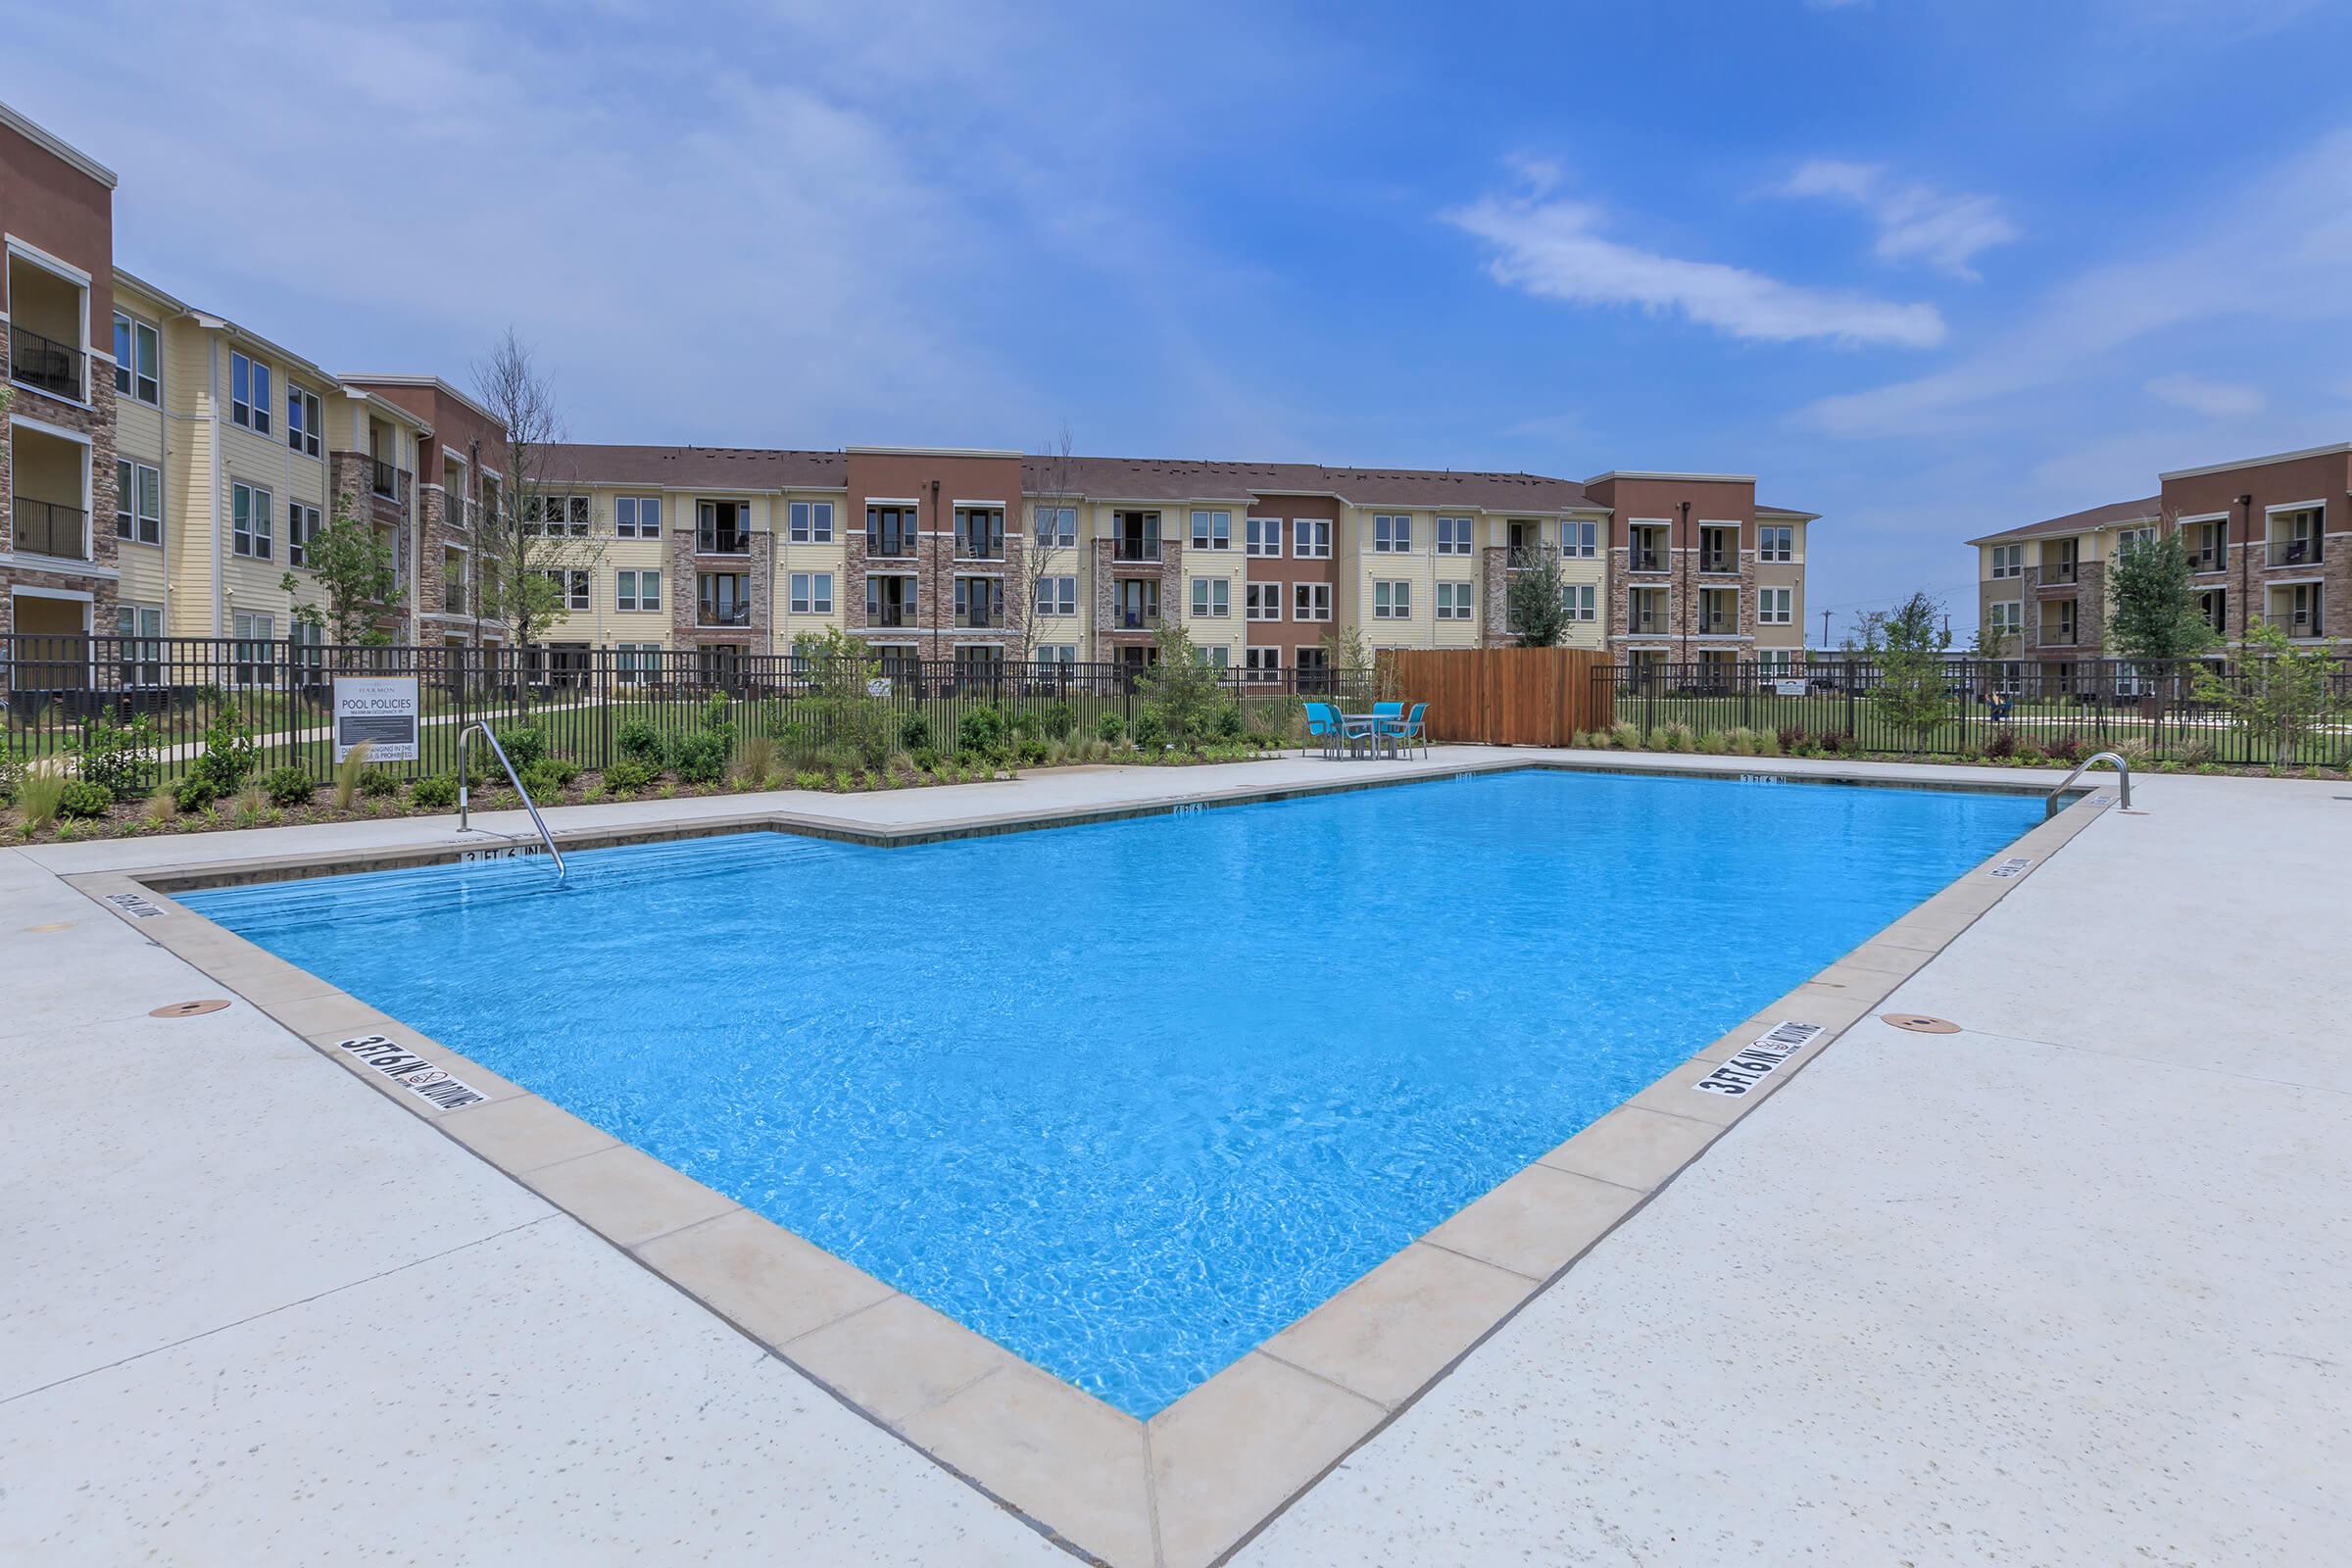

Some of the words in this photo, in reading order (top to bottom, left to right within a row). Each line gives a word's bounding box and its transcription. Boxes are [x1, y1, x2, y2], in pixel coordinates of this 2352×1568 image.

[342, 699, 368, 709] POOL
[371, 699, 412, 709] POLICIES
[341, 1036, 385, 1049] 3
[369, 1054, 416, 1066] 6
[1699, 1081, 1746, 1095] 3
[1730, 1059, 1773, 1072] 6
